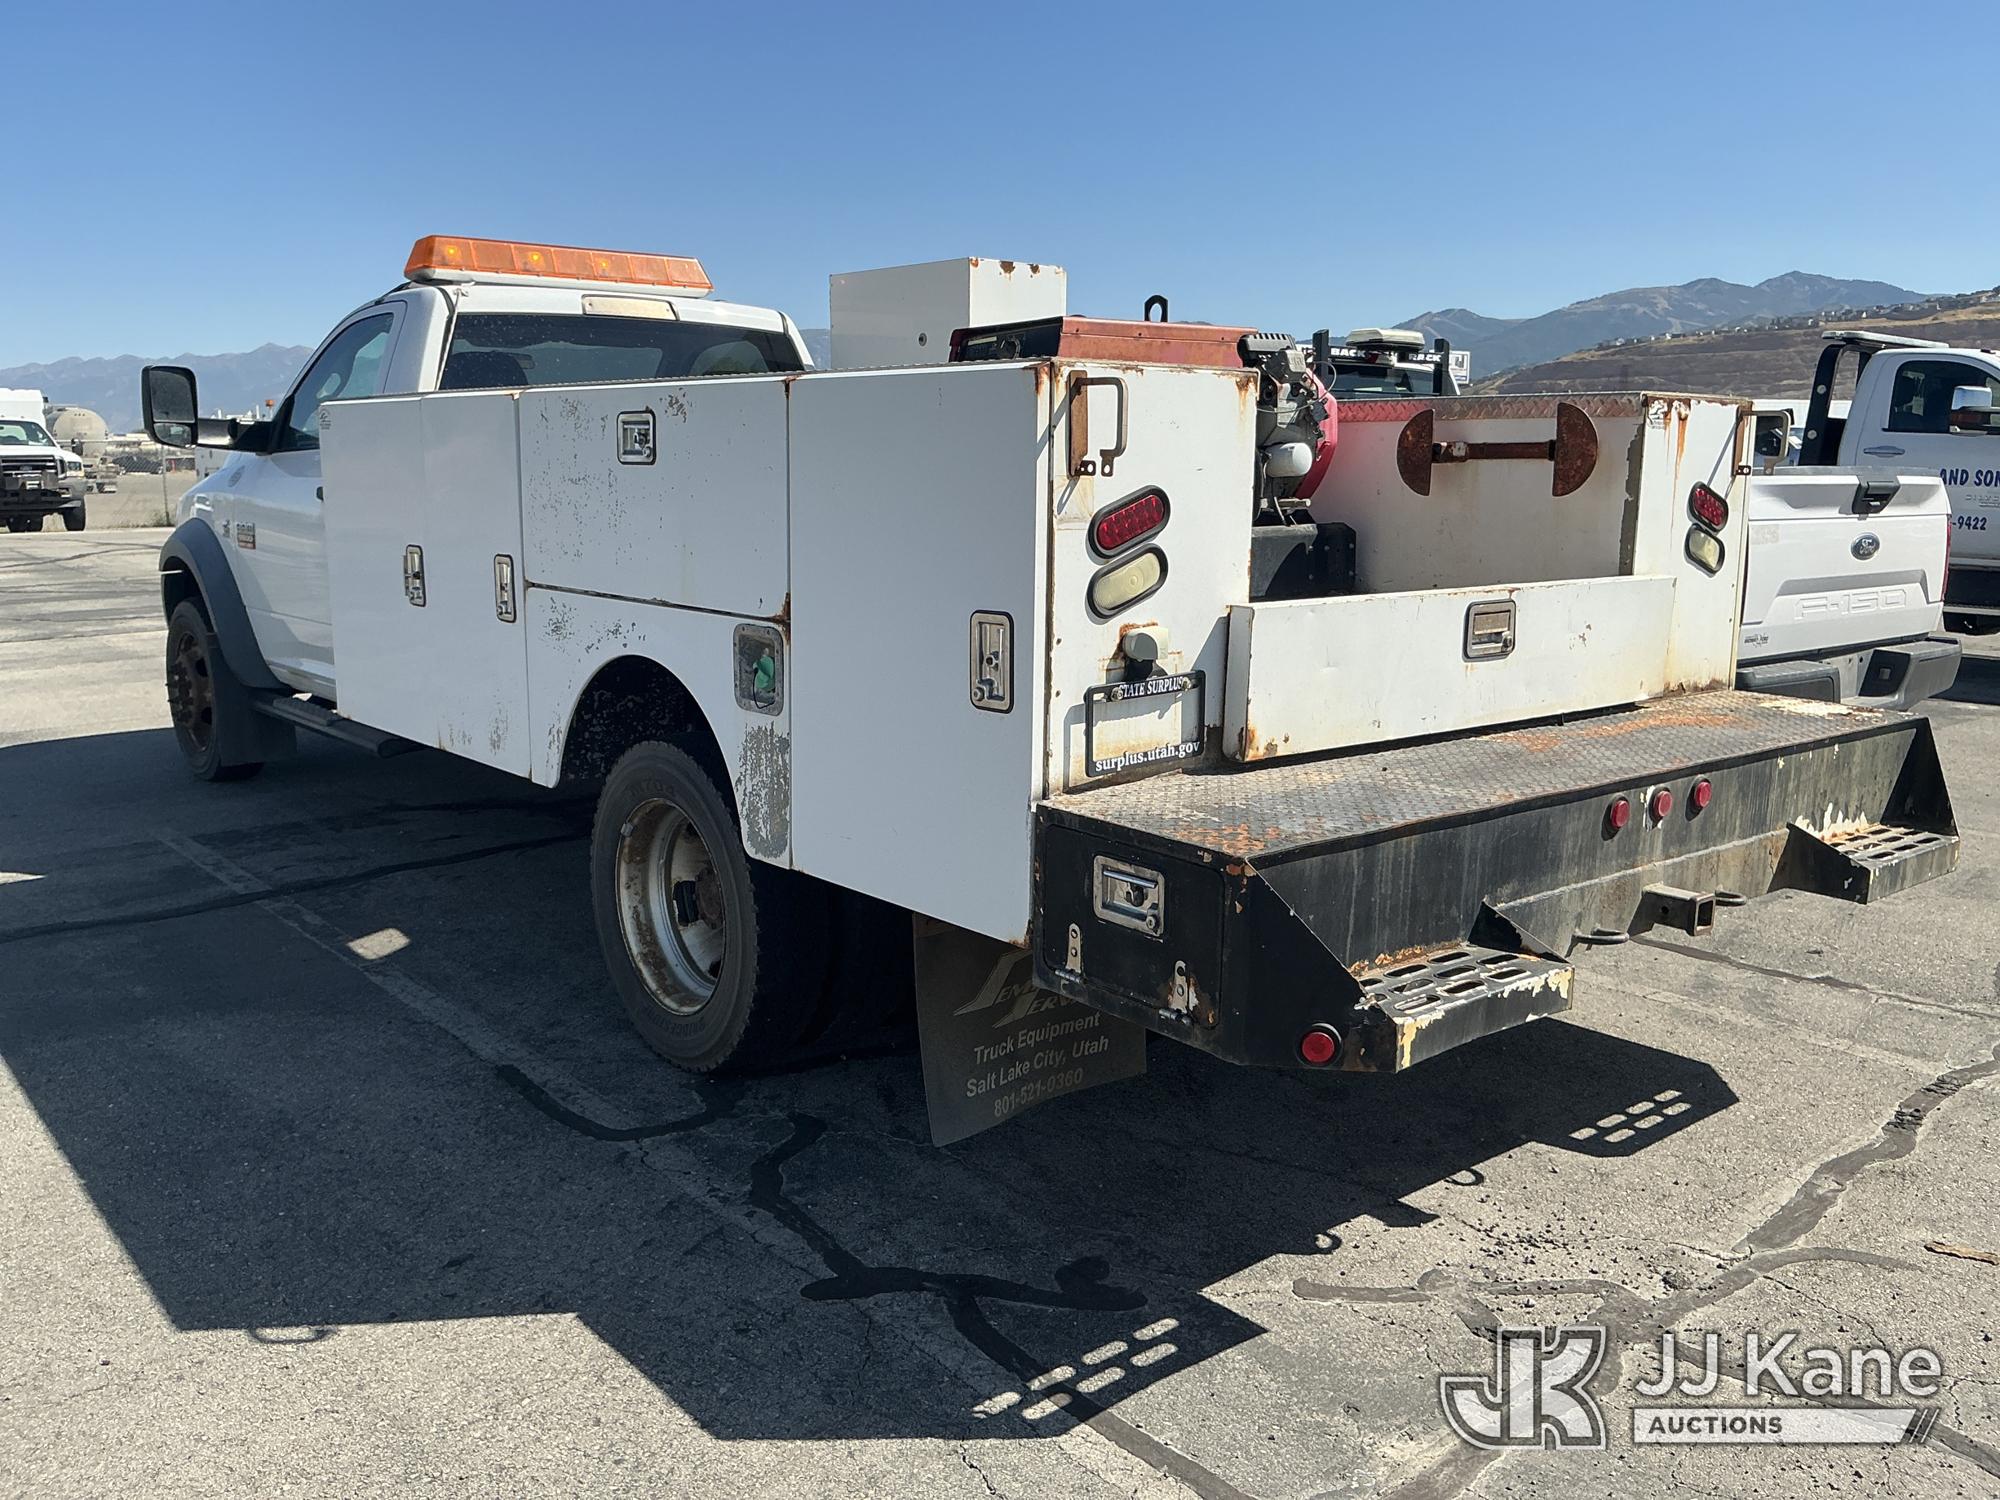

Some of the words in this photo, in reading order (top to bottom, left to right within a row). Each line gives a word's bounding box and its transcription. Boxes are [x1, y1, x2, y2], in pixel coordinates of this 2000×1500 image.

[1331, 348, 1367, 357] BACK
[1408, 352, 1442, 362] RACK
[1940, 468, 1969, 486] AND
[1794, 589, 1906, 619] F-150
[1118, 682, 1146, 698] STATE
[1147, 677, 1183, 695] SURPLUS
[1095, 741, 1200, 773] surplus.utah.gov
[973, 1037, 1014, 1065] Truck
[1017, 1011, 1100, 1049] Equipment
[966, 1070, 996, 1098] Salt
[1000, 1061, 1030, 1085] Lake
[1033, 1049, 1066, 1070] City,
[1073, 1036, 1109, 1058] Utah
